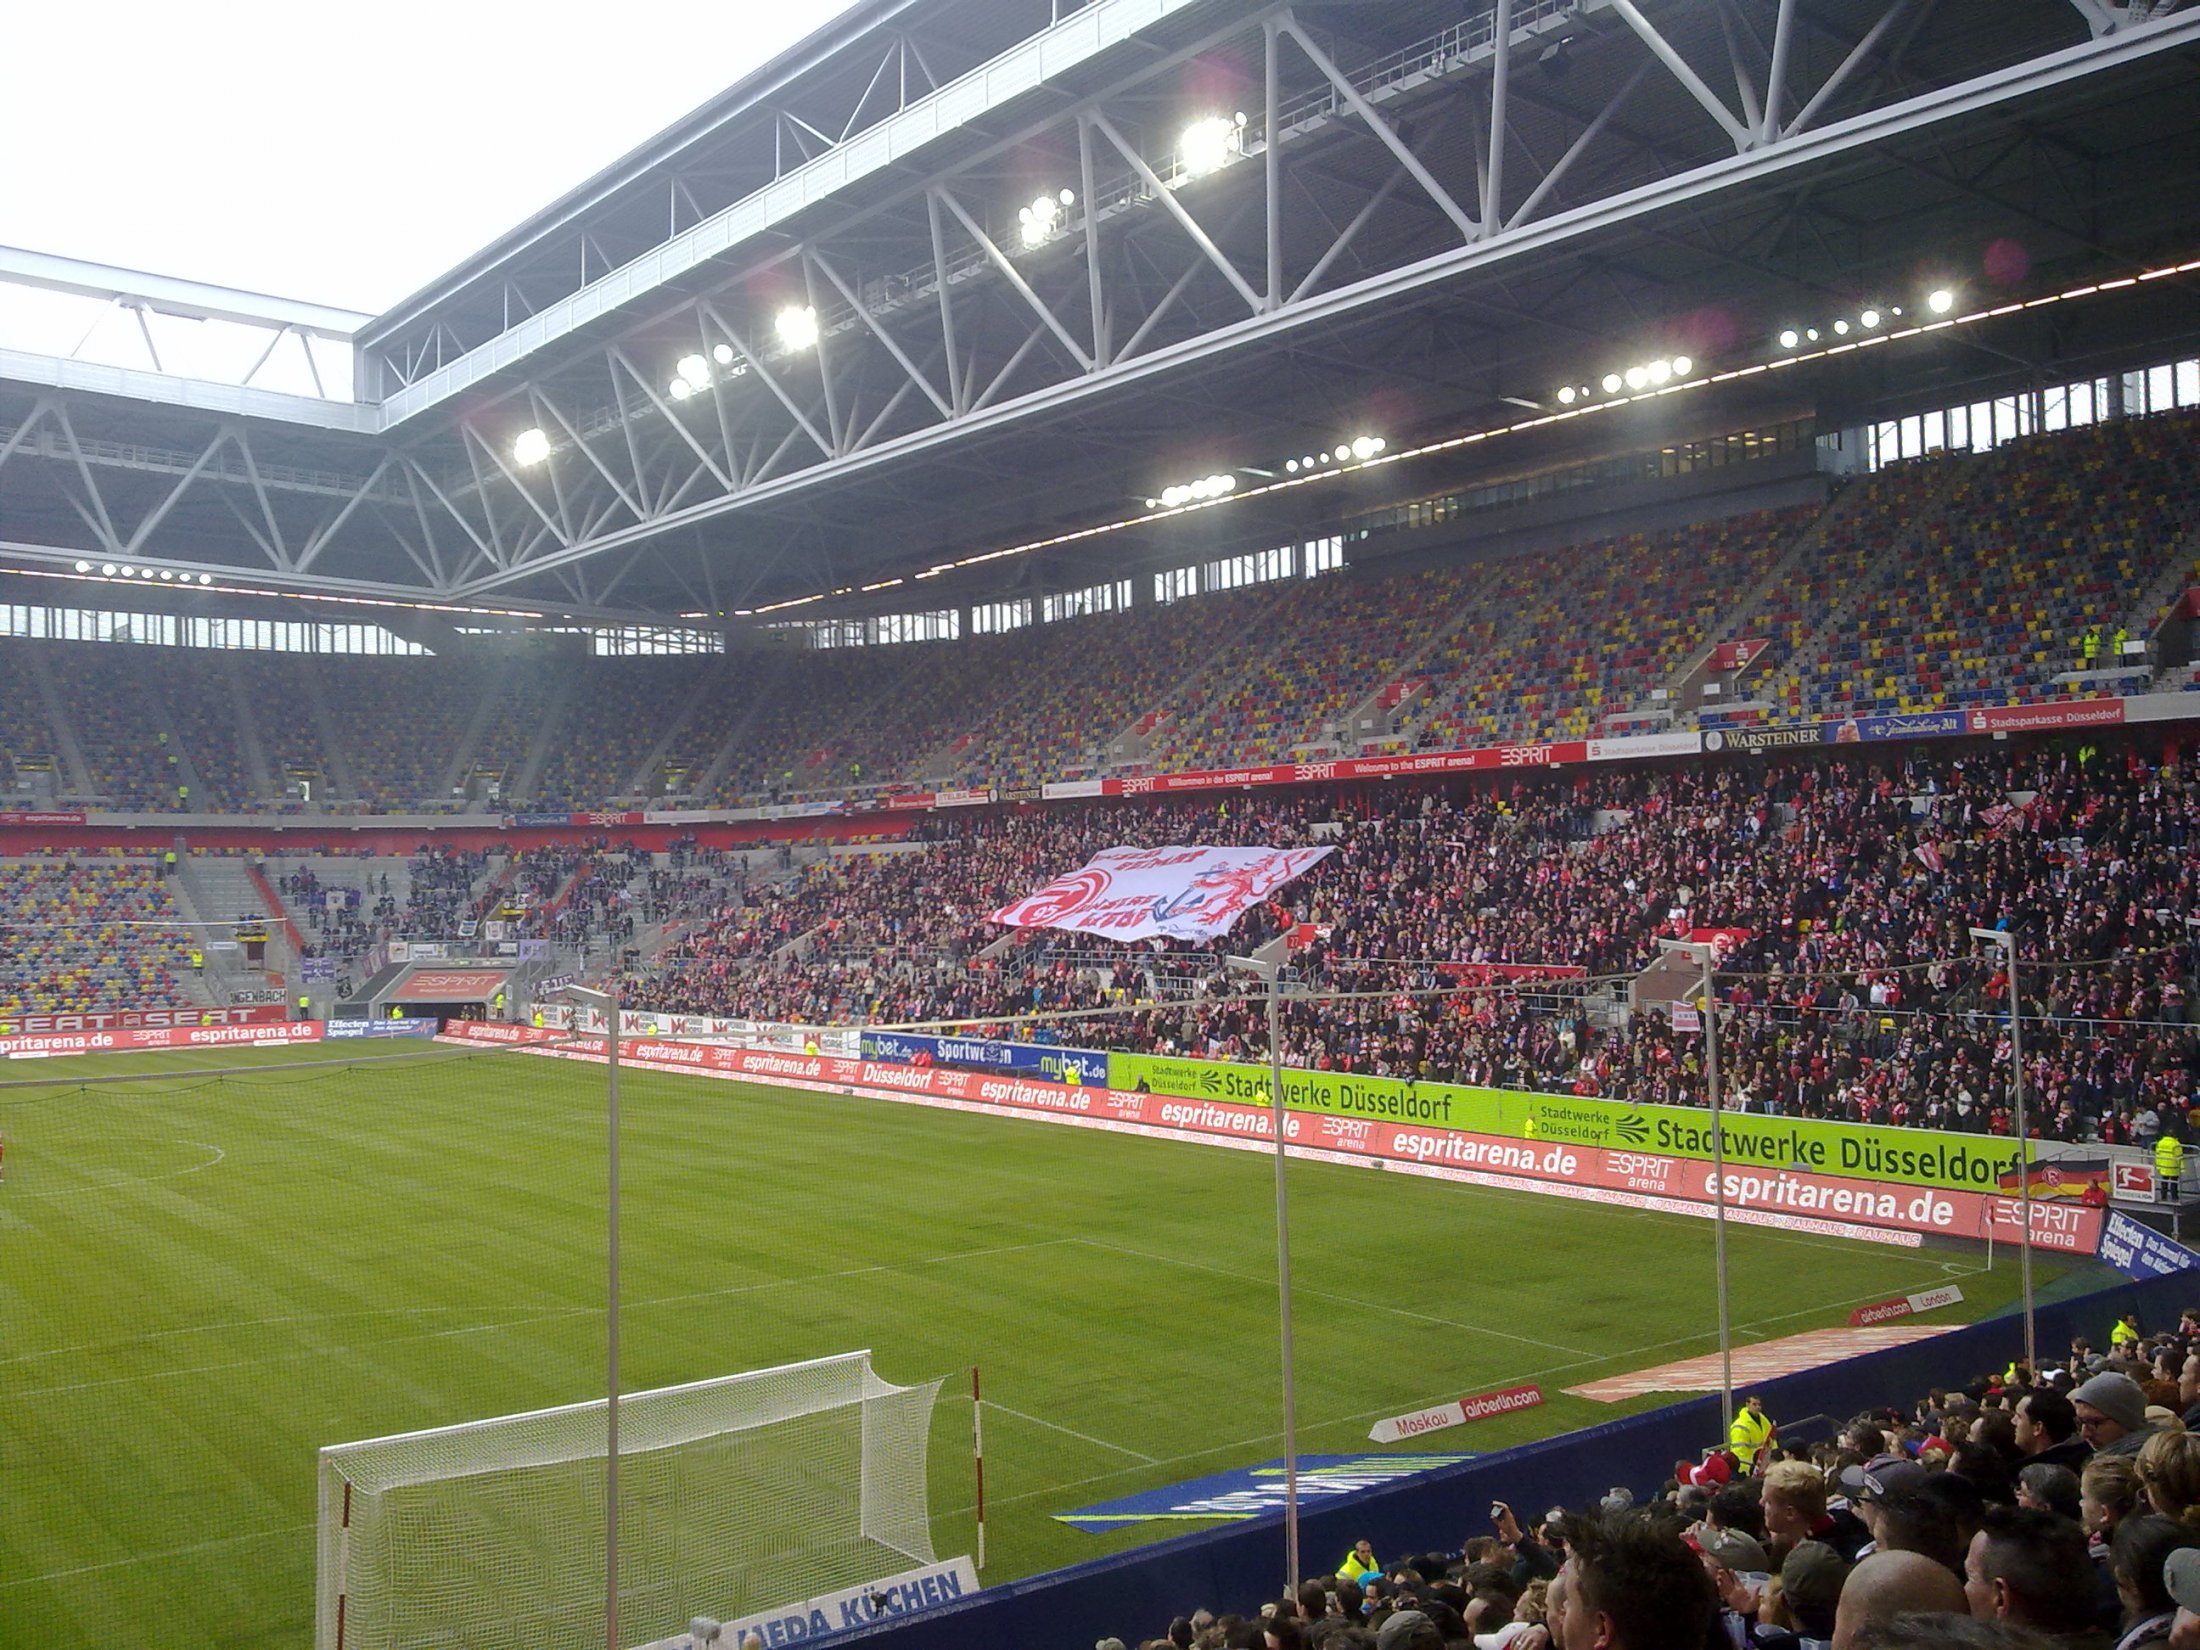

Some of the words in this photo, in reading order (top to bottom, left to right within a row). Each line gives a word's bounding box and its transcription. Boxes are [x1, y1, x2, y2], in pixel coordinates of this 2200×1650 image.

[1991, 714, 2063, 729] Stadtsparkasse
[2066, 707, 2121, 723] Düsseldorf
[1725, 729, 1820, 748] WARSTEINER
[1354, 763, 1390, 774] Welcome
[1390, 762, 1400, 771] to
[1400, 760, 1413, 770] the
[1414, 757, 1446, 770] ESPRIT
[1447, 755, 1475, 767] arena!
[1501, 745, 1553, 766] ESPRIT
[1167, 776, 1206, 788] Willkommen
[1213, 775, 1225, 785] der
[1225, 772, 1250, 784] ESPRIT
[1250, 770, 1274, 782] arena!
[1295, 763, 1337, 781] ESPRIT
[1121, 777, 1156, 793] ESPRIT
[589, 813, 629, 825] ESPRIT
[413, 975, 497, 987] ESPRIT
[133, 1029, 172, 1041] ESPRIT
[190, 1023, 312, 1044] espritarena.de
[327, 1027, 364, 1038] Spiegel
[636, 1042, 704, 1063] espritarena.de
[742, 1053, 822, 1076] espritarena.de
[832, 1059, 861, 1074] ESPRIT
[1151, 1065, 1197, 1078] Stadtwerke
[862, 1063, 933, 1089] Düsseldorf
[937, 1071, 972, 1087] ESPRIT
[1151, 1078, 1197, 1092] Düsseldorf
[980, 1080, 1091, 1110] espritarena.de
[1106, 1090, 1147, 1111] ESPRIT
[1340, 1083, 1453, 1121] Düsseldorf
[1540, 1105, 1610, 1125] Stadtwerke
[1321, 1116, 1374, 1140] ESPRIT
[1540, 1122, 1610, 1141] Düsseldorf
[1336, 1136, 1366, 1150] arena
[1656, 1118, 1826, 1166] Stadtwerke
[1392, 1131, 1578, 1176] espritarena.de
[1606, 1151, 1676, 1180] ESPRIT
[1627, 1176, 1666, 1192] arena
[1704, 1171, 1955, 1227] espritarena.de
[1654, 1200, 1710, 1216] BAUHAUS
[1785, 1217, 1847, 1236] BAUHAUS
[1855, 1227, 1921, 1247] BAUHAUS
[1994, 1198, 2087, 1233] ESPRIT
[2028, 1230, 2076, 1248] arena
[2107, 1211, 2146, 1251] Effecten
[2100, 1232, 2135, 1270] Spiegel
[1860, 1302, 1912, 1324] airberlin.com
[1919, 1291, 1953, 1308] London
[1395, 1412, 1449, 1436] Moskau
[1465, 1389, 1541, 1418] airberlin.com
[839, 1570, 962, 1628] KÜCHEN
